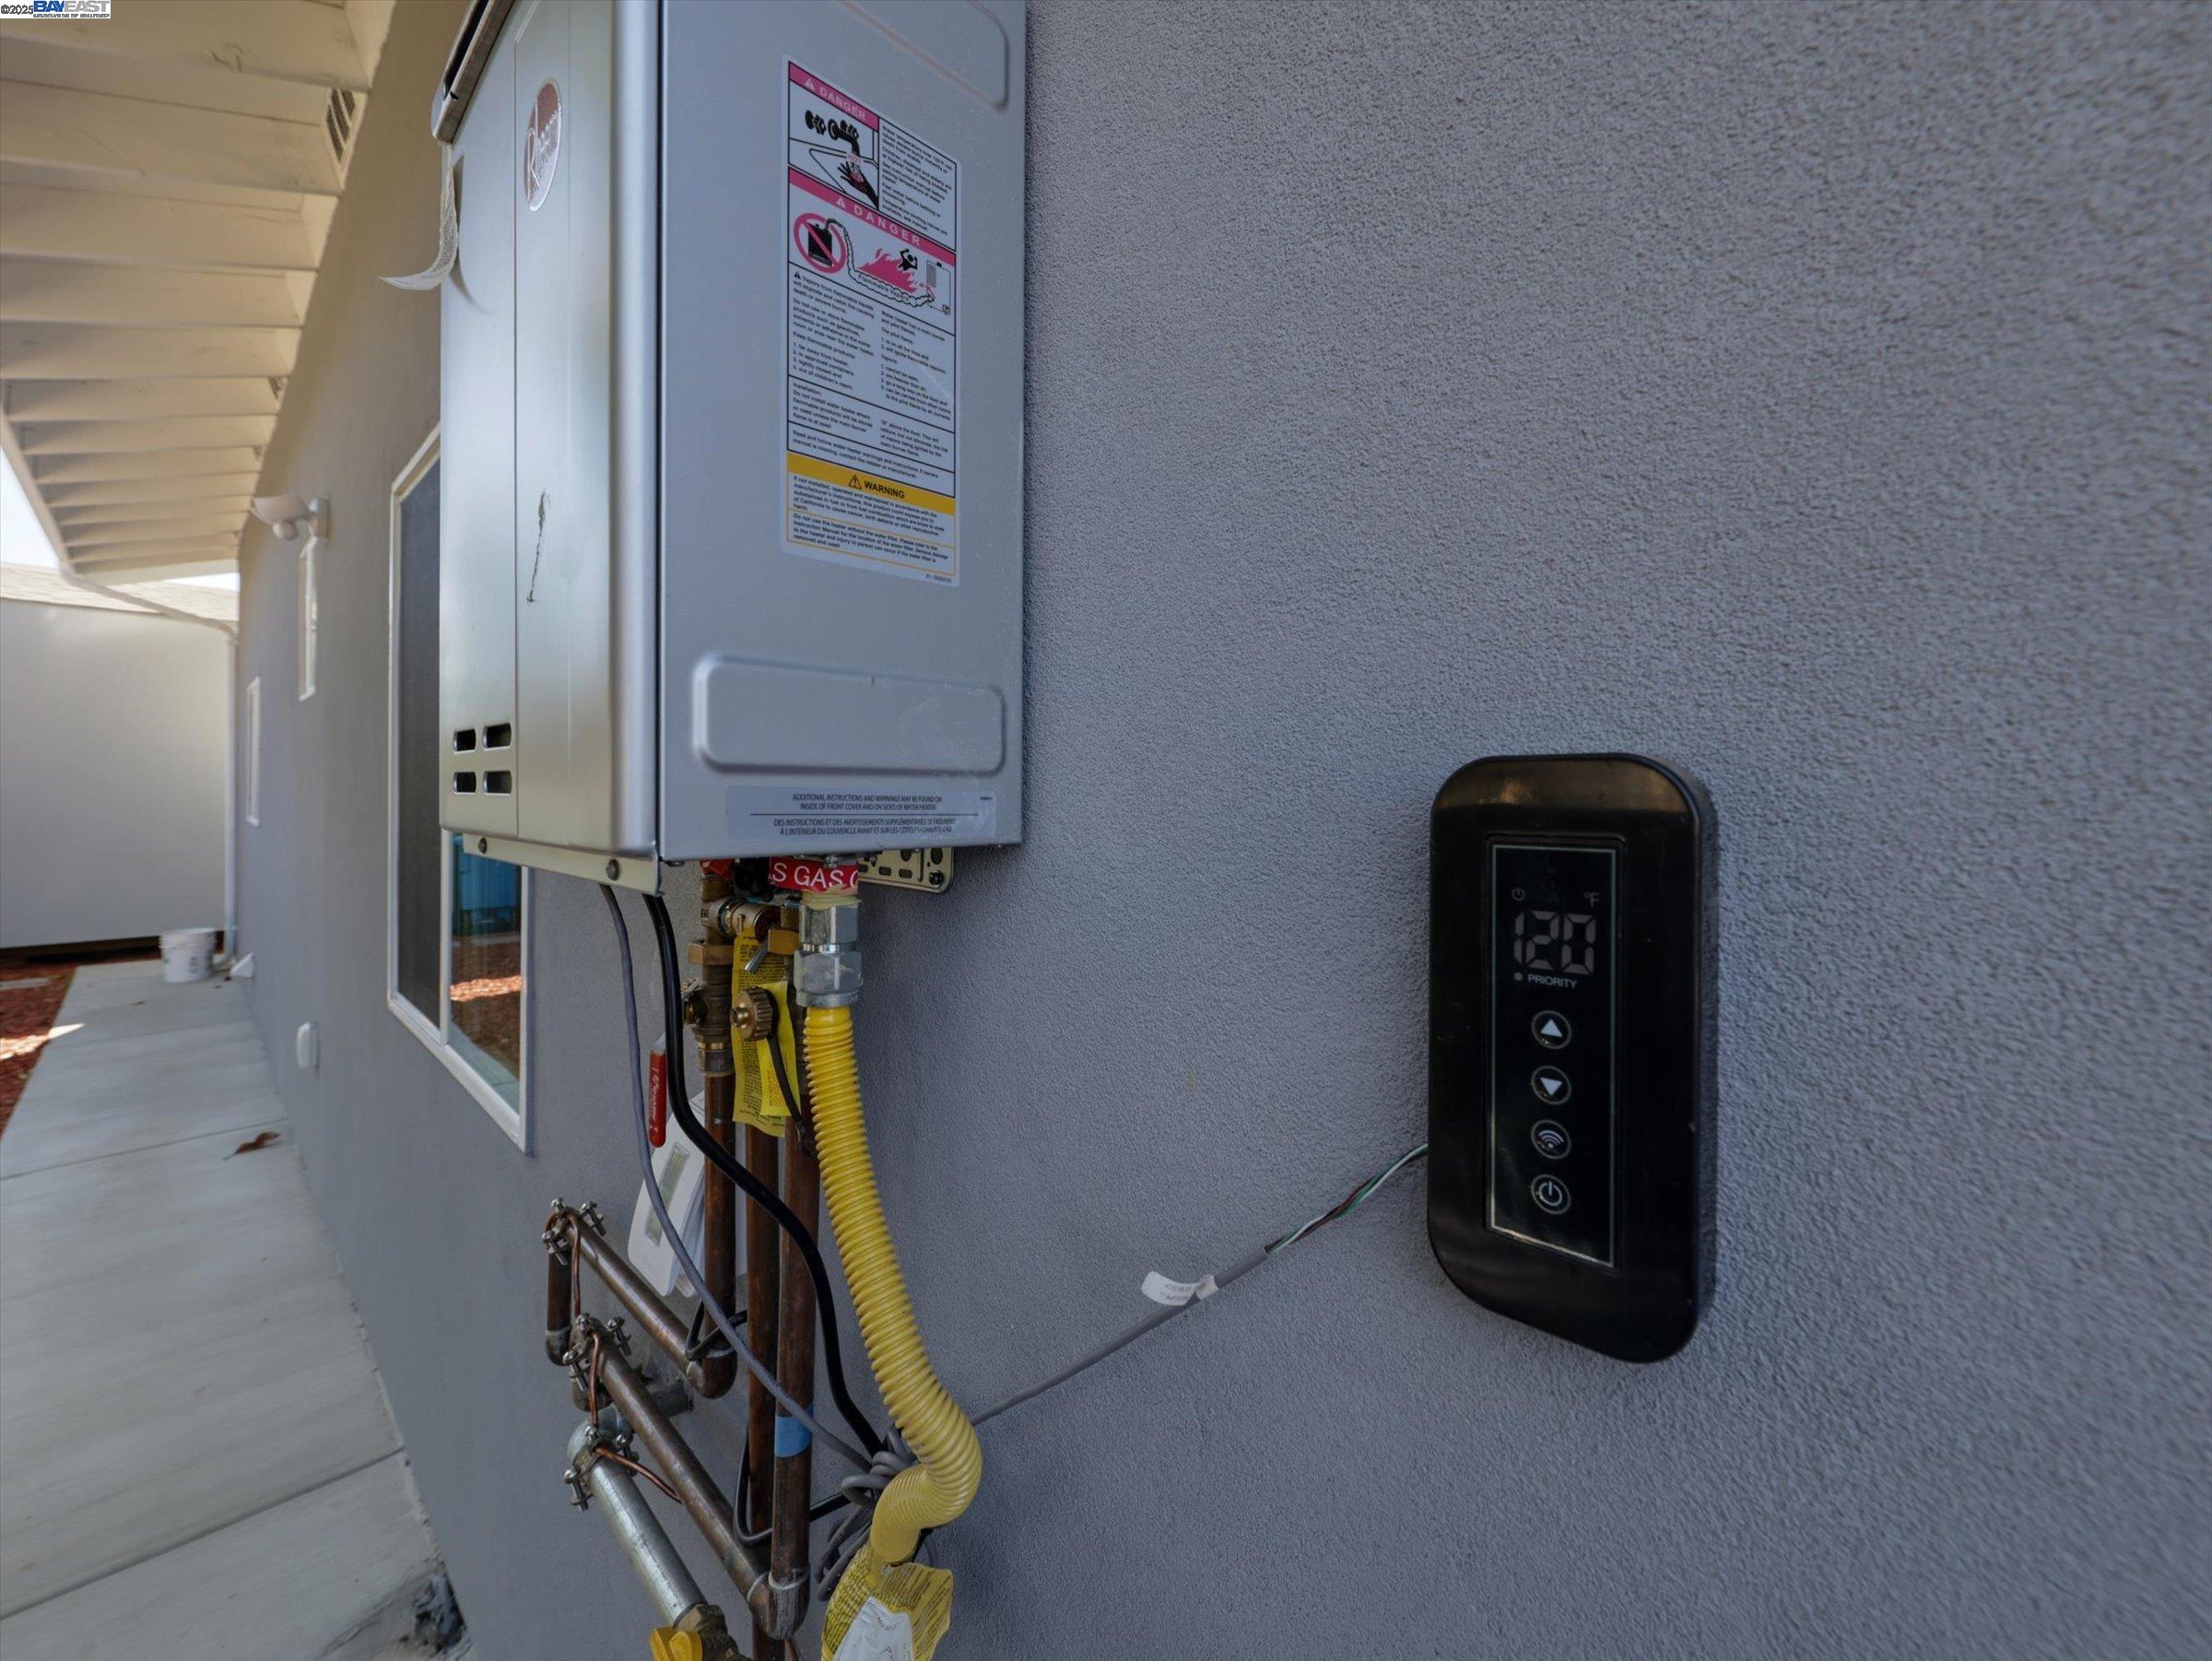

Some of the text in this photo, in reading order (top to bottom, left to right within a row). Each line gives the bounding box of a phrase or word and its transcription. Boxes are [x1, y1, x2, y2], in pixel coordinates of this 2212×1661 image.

[820, 86, 866, 122] DANGER
[854, 203, 921, 248] DANGER
[865, 480, 905, 500] WARNING
[827, 794, 863, 802] INSTRUCTIONS
[794, 866, 843, 889] GAS
[1583, 891, 1599, 908] °F
[1513, 910, 1596, 975] 120
[1527, 973, 1578, 988] PRIORITY
